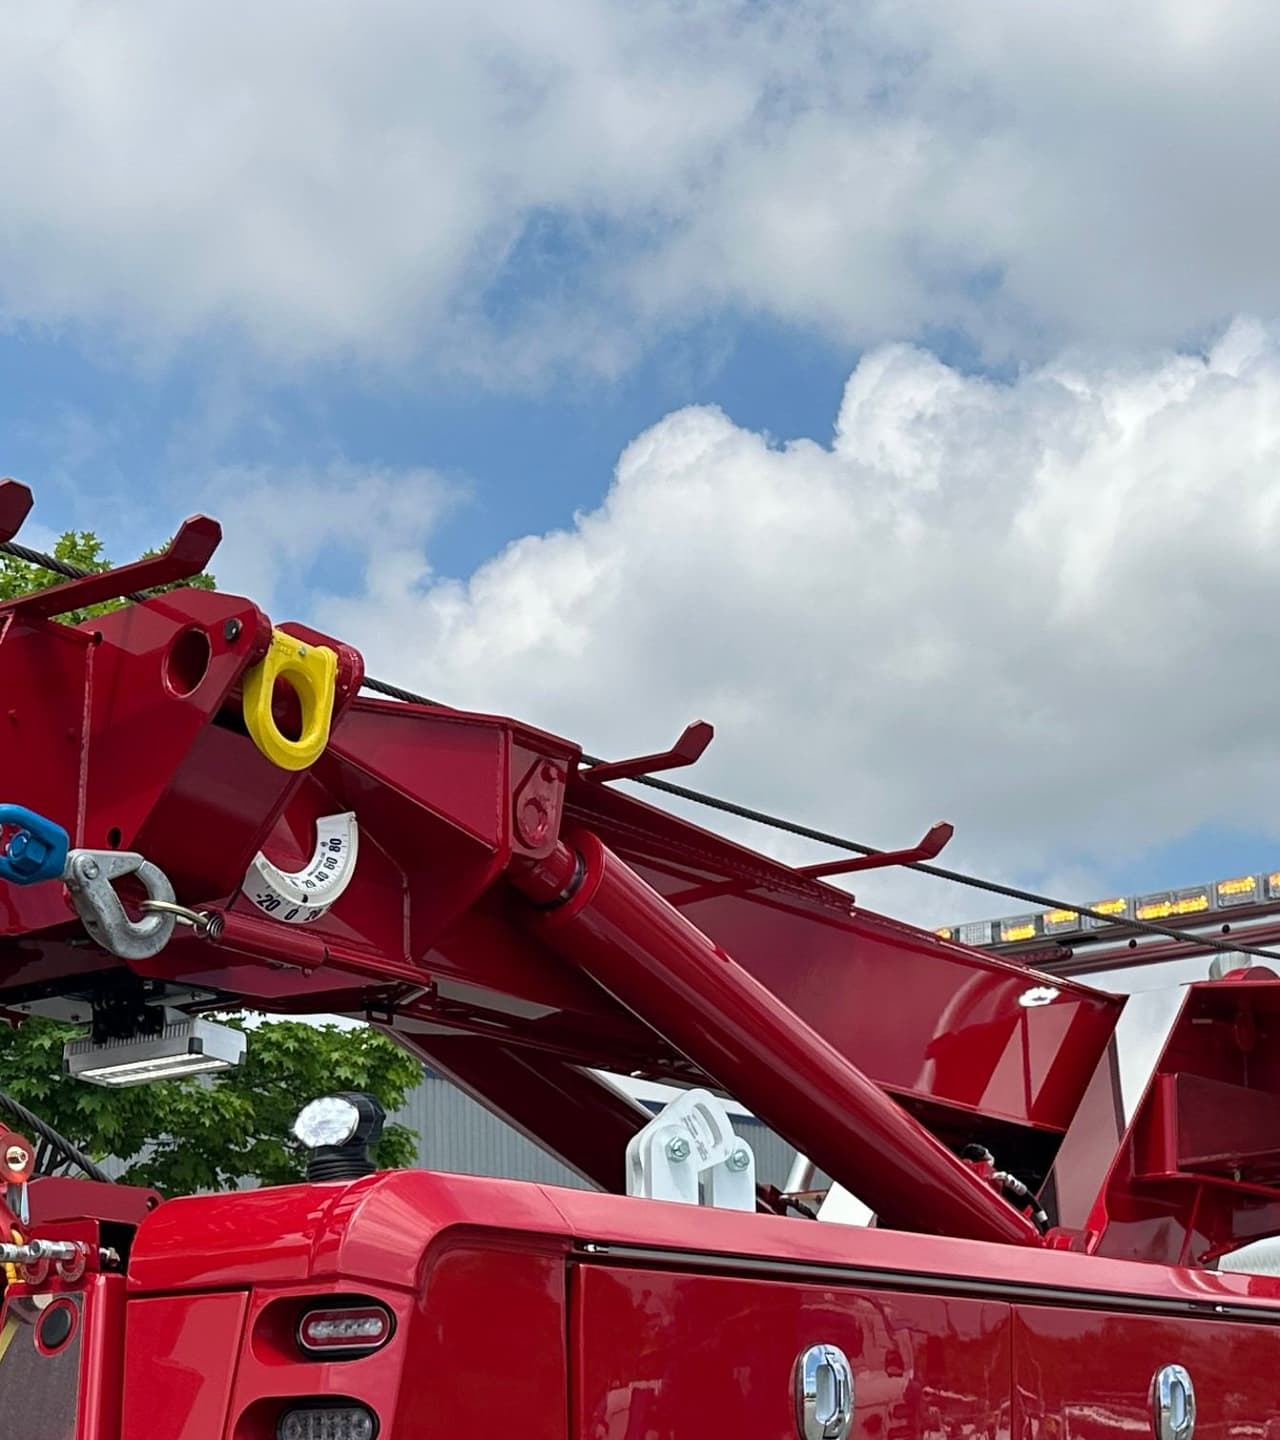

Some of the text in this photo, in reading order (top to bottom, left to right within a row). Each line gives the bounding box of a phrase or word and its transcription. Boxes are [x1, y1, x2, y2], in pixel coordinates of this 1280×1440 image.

[328, 838, 342, 853] 80
[323, 856, 338, 871] 60
[315, 871, 329, 883] 40
[256, 893, 281, 912] -20
[284, 908, 299, 921] 0
